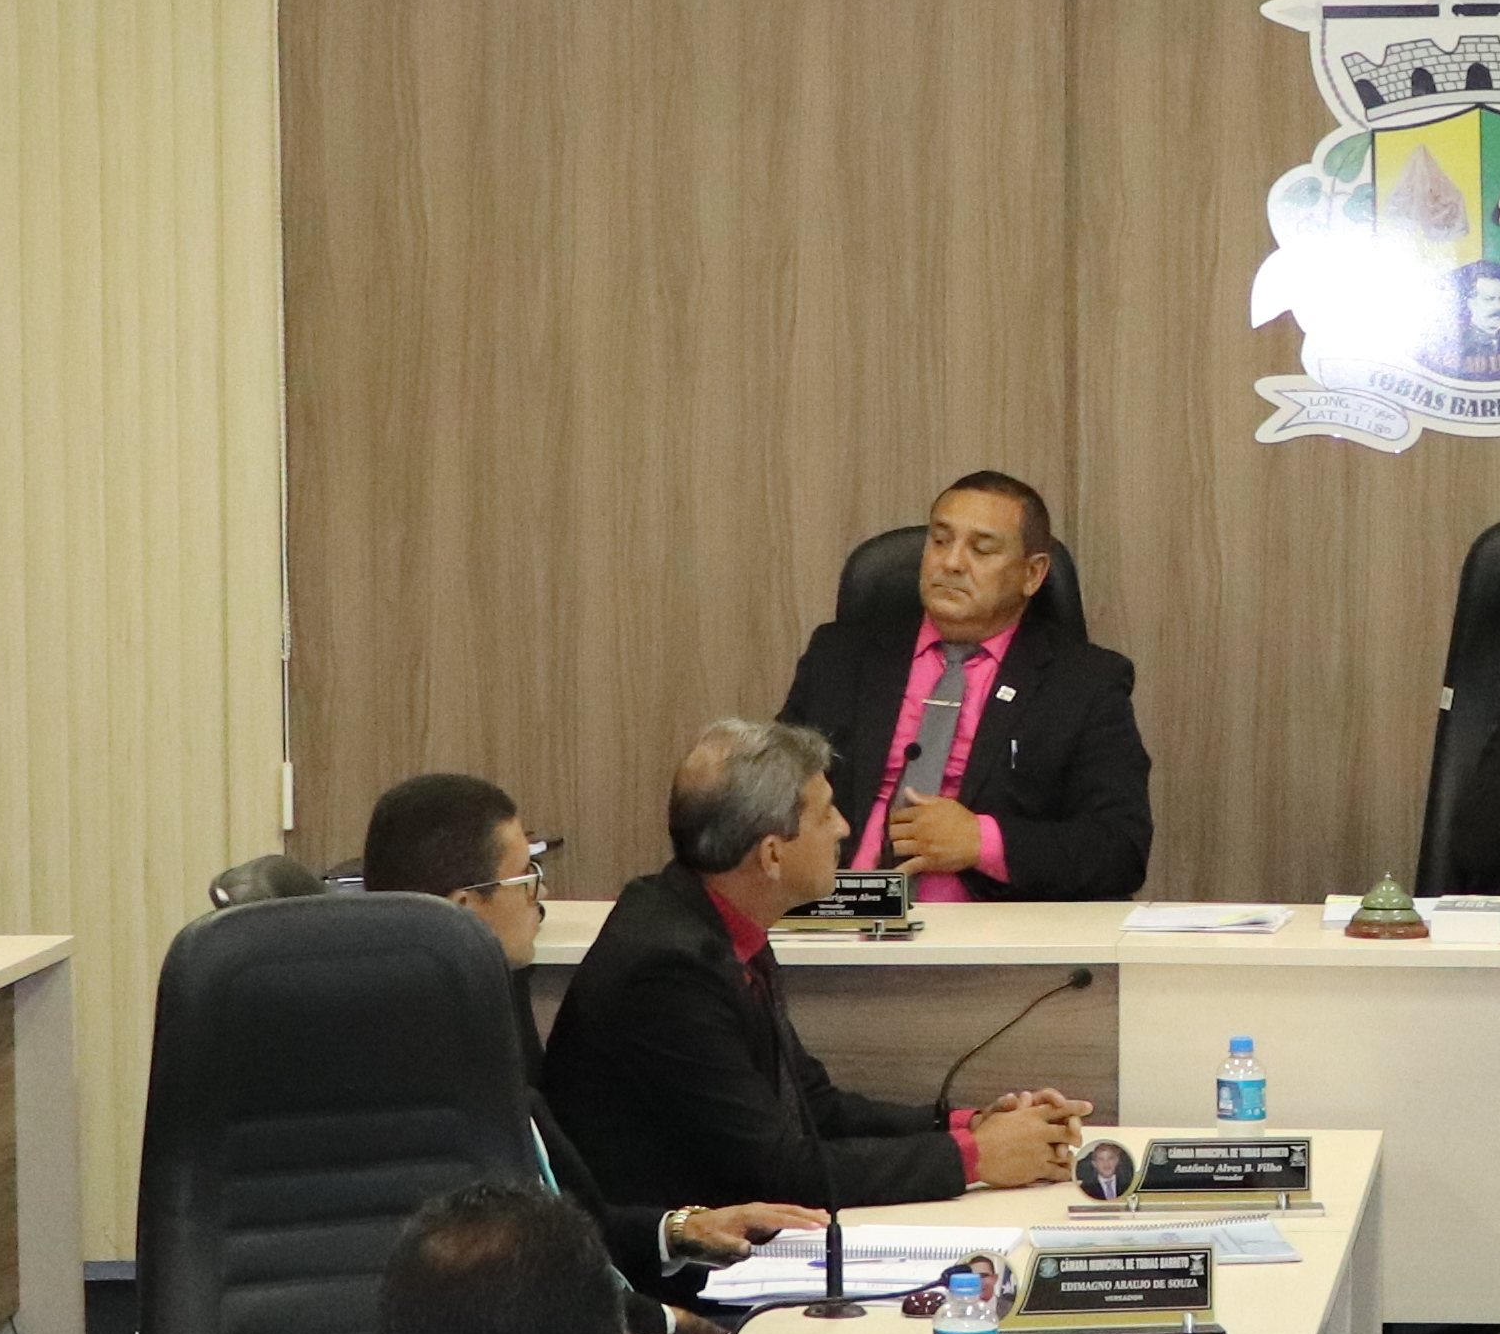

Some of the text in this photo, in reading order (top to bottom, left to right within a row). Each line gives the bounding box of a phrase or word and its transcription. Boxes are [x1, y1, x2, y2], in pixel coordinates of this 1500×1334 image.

[1367, 370, 1447, 411] TOBIAS
[1215, 1163, 1243, 1173] Alves
[1257, 1162, 1283, 1173] Filho
[1060, 1281, 1113, 1292] EDIMAGNO
[1152, 1279, 1166, 1289] DE
[1167, 1278, 1199, 1289] SOUZA
